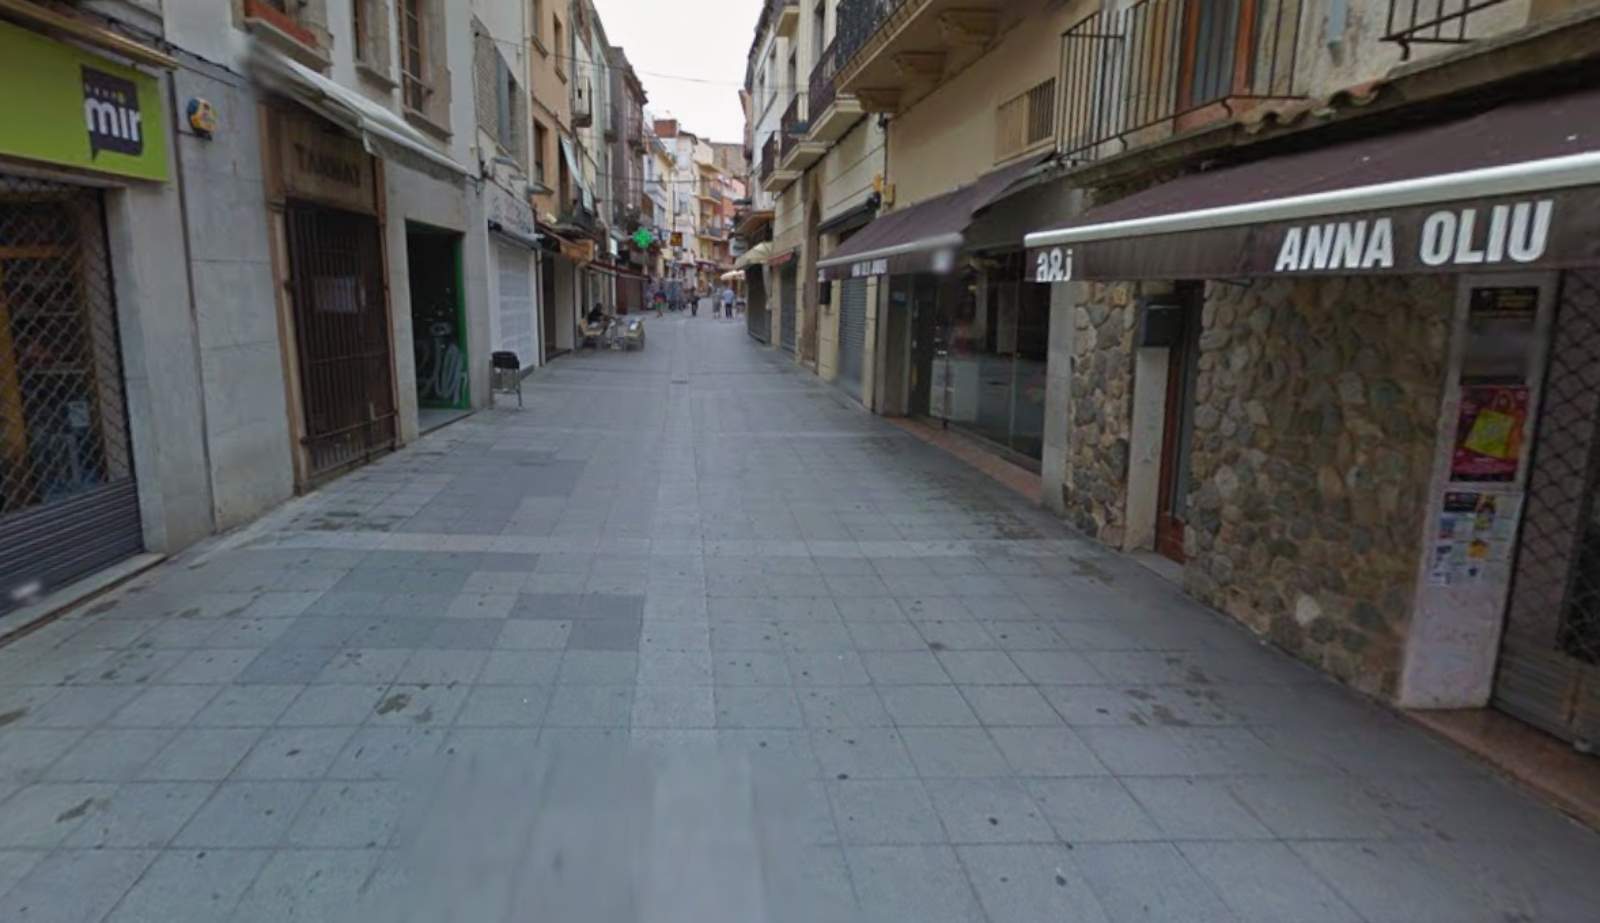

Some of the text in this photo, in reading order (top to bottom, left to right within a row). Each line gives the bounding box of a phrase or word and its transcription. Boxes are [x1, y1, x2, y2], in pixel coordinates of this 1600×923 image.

[84, 97, 142, 141] mir
[1275, 201, 1554, 271] ANNA OLIU
[1036, 248, 1073, 282] a&j
